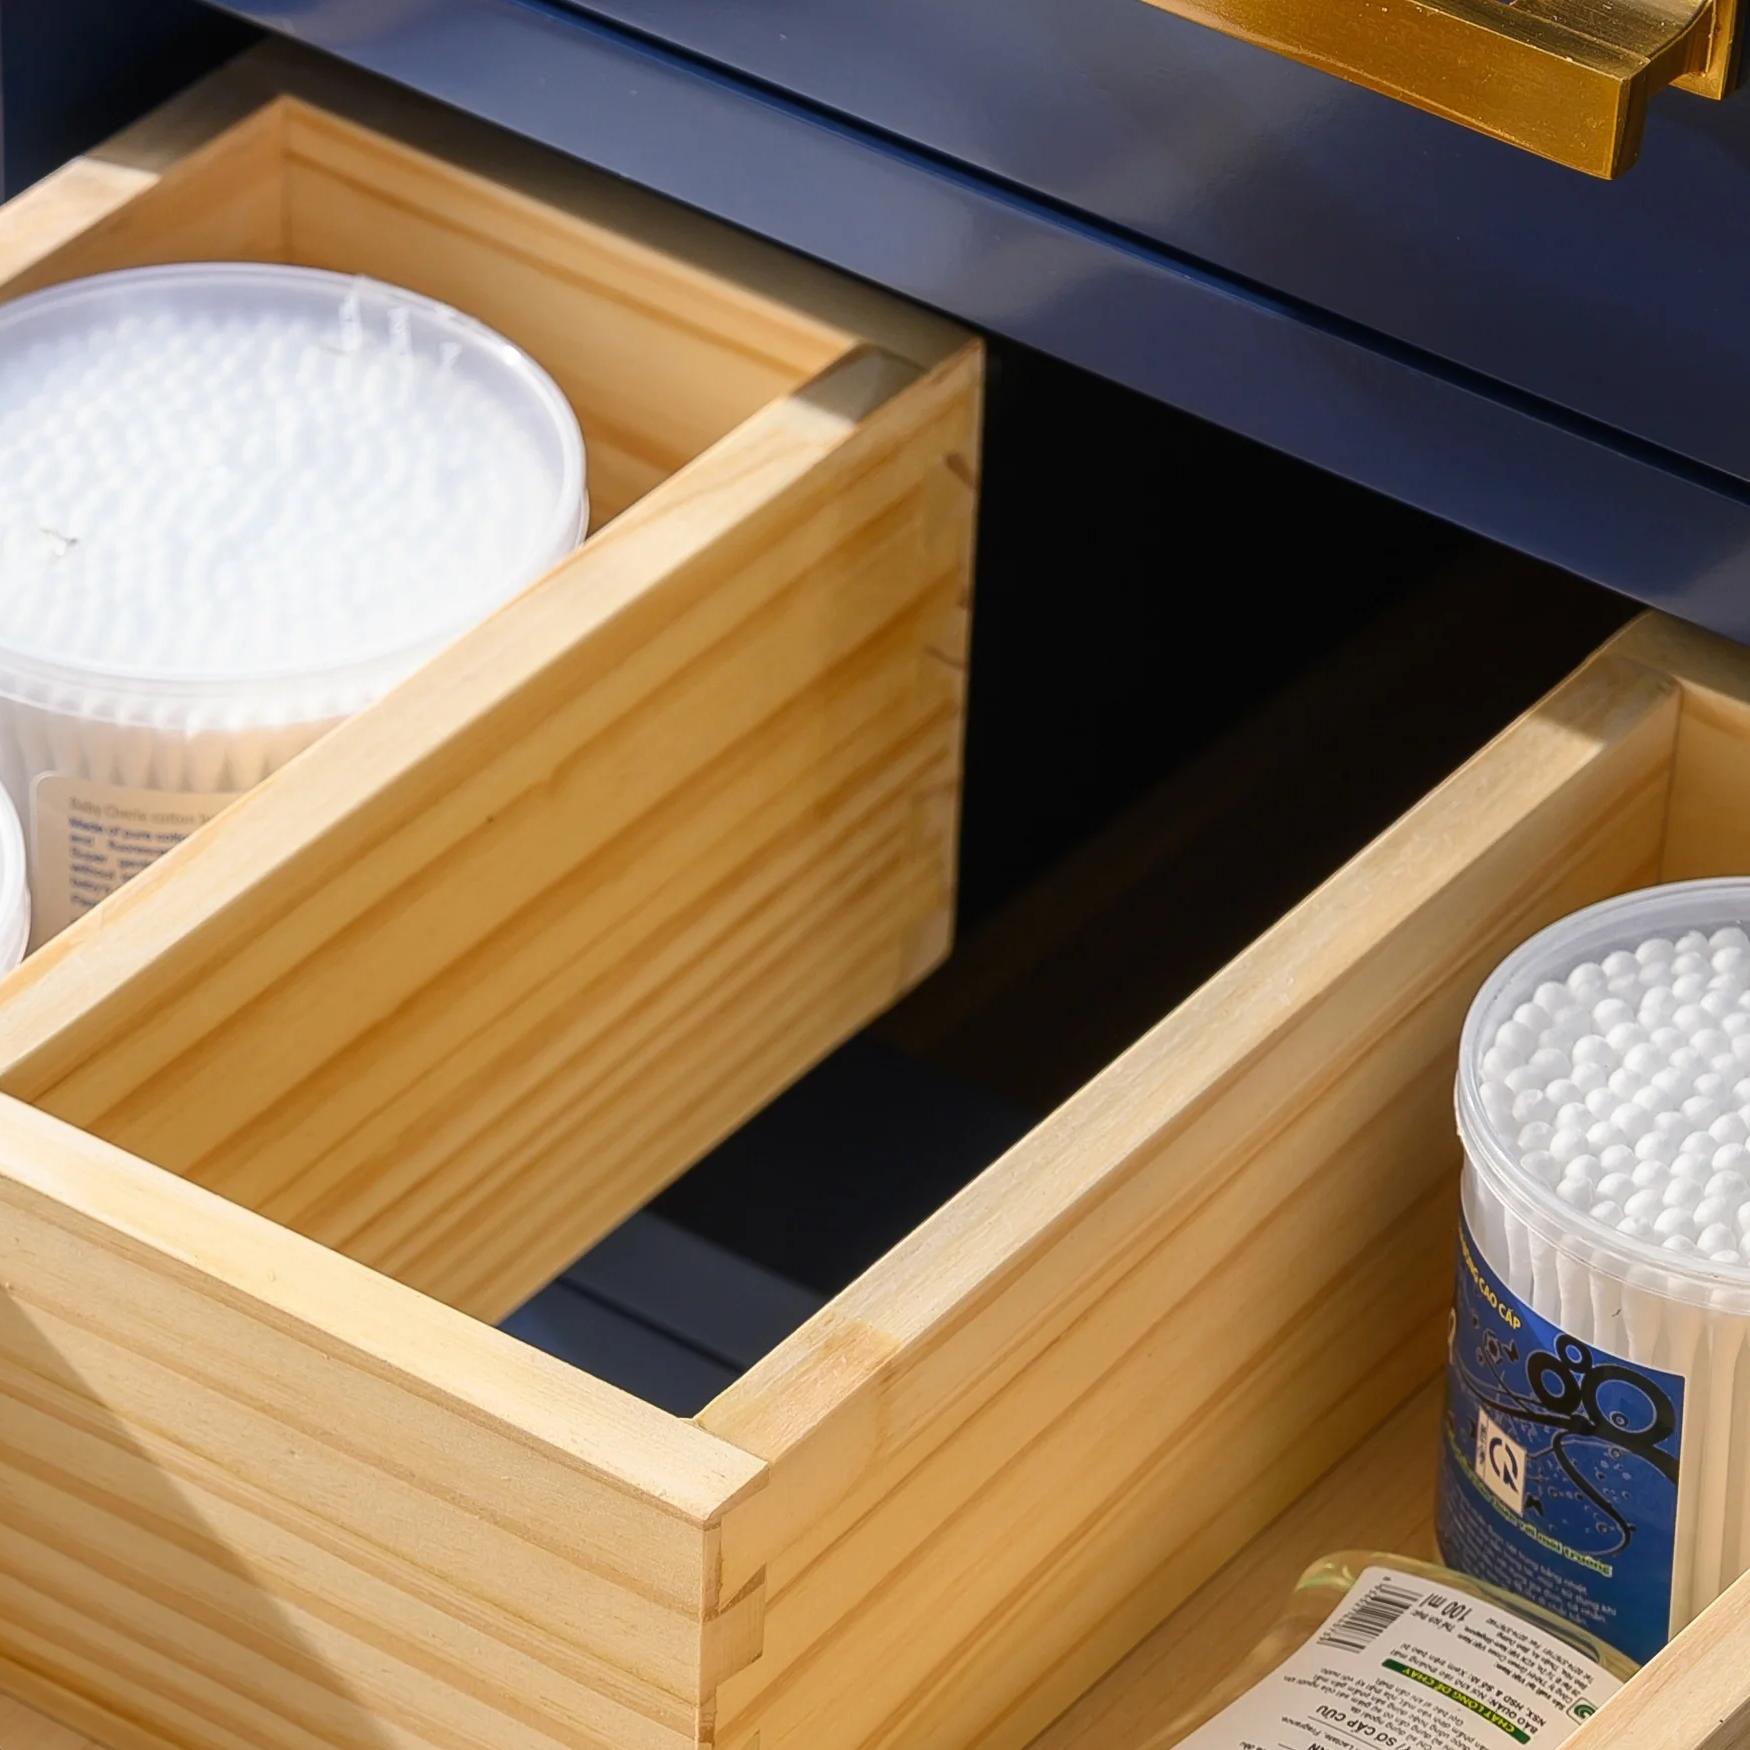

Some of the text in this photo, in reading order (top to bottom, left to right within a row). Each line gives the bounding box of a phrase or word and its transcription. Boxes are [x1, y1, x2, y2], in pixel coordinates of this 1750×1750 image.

[1419, 1593, 1473, 1622] 100 ml
[1346, 1720, 1376, 1736] CẤP
